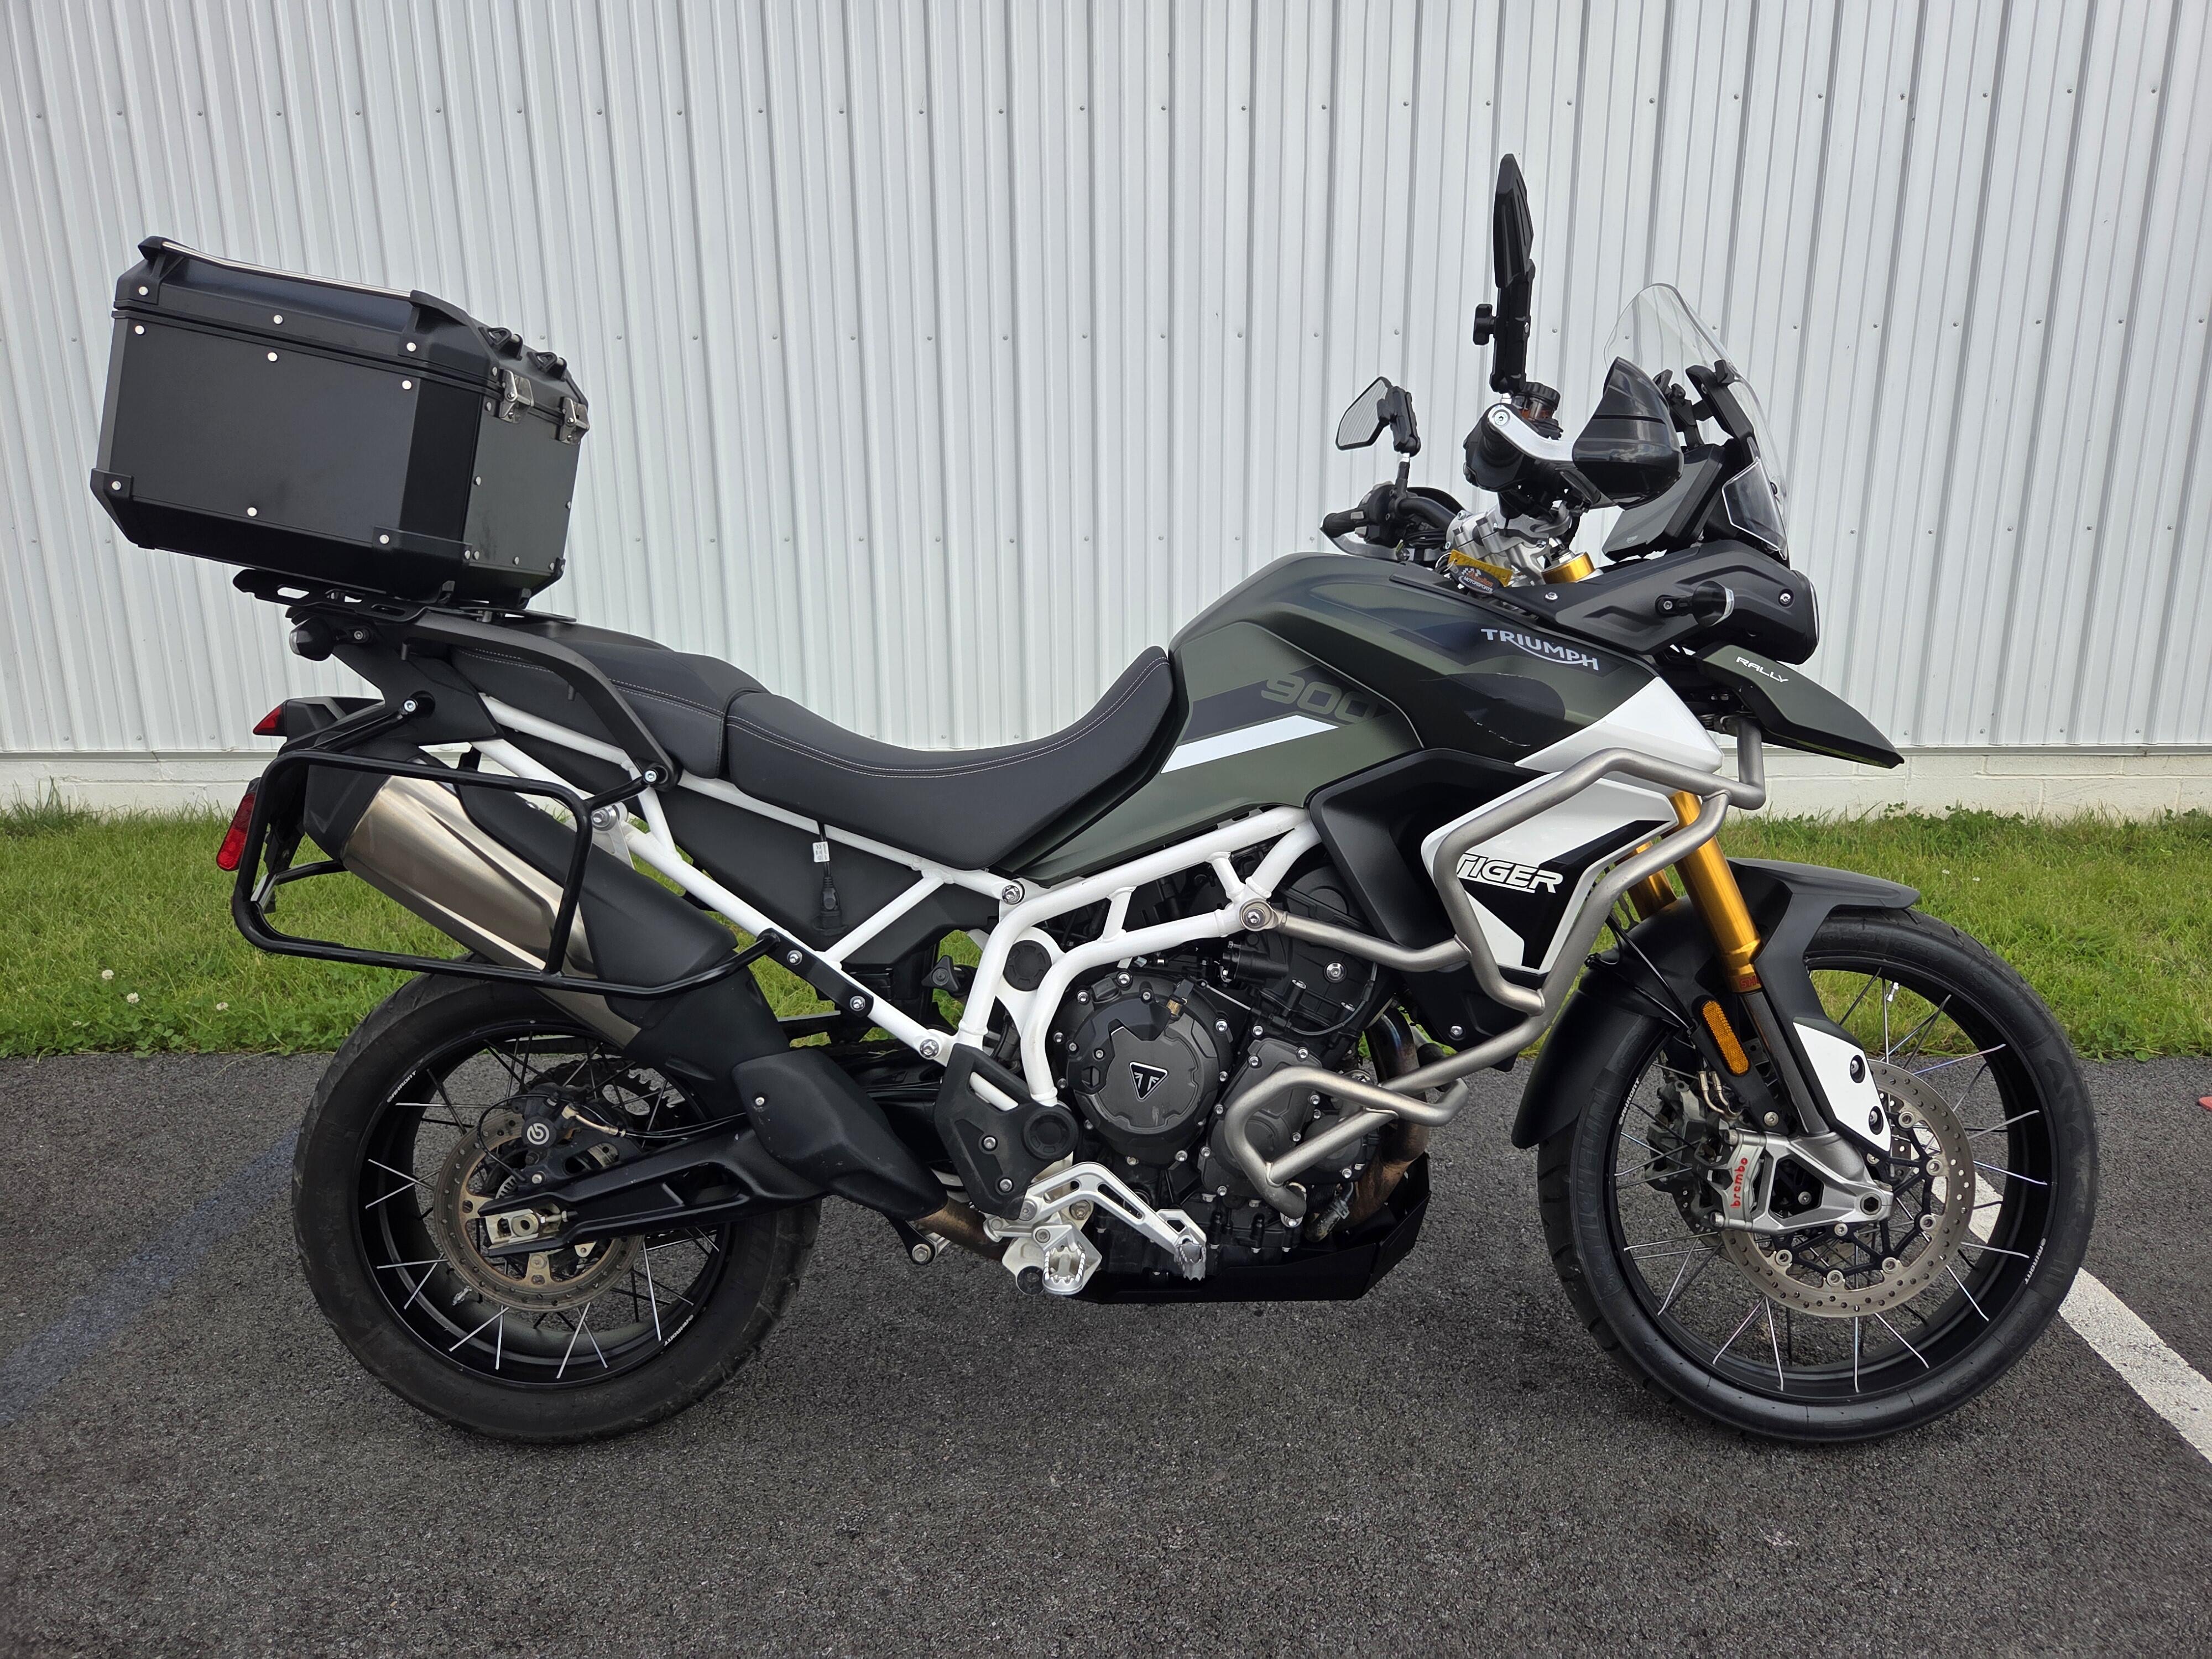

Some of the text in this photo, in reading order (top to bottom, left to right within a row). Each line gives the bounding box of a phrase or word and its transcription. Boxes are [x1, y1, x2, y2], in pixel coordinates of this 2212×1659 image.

[1463, 576, 1493, 592] MOTORSPORTS
[1481, 629, 1599, 670] TRIUMPH
[1736, 656, 1789, 682] RALLY
[1261, 674, 1378, 723] 900
[1456, 853, 1563, 893] TIGER
[1730, 1157, 1748, 1208] brembo
